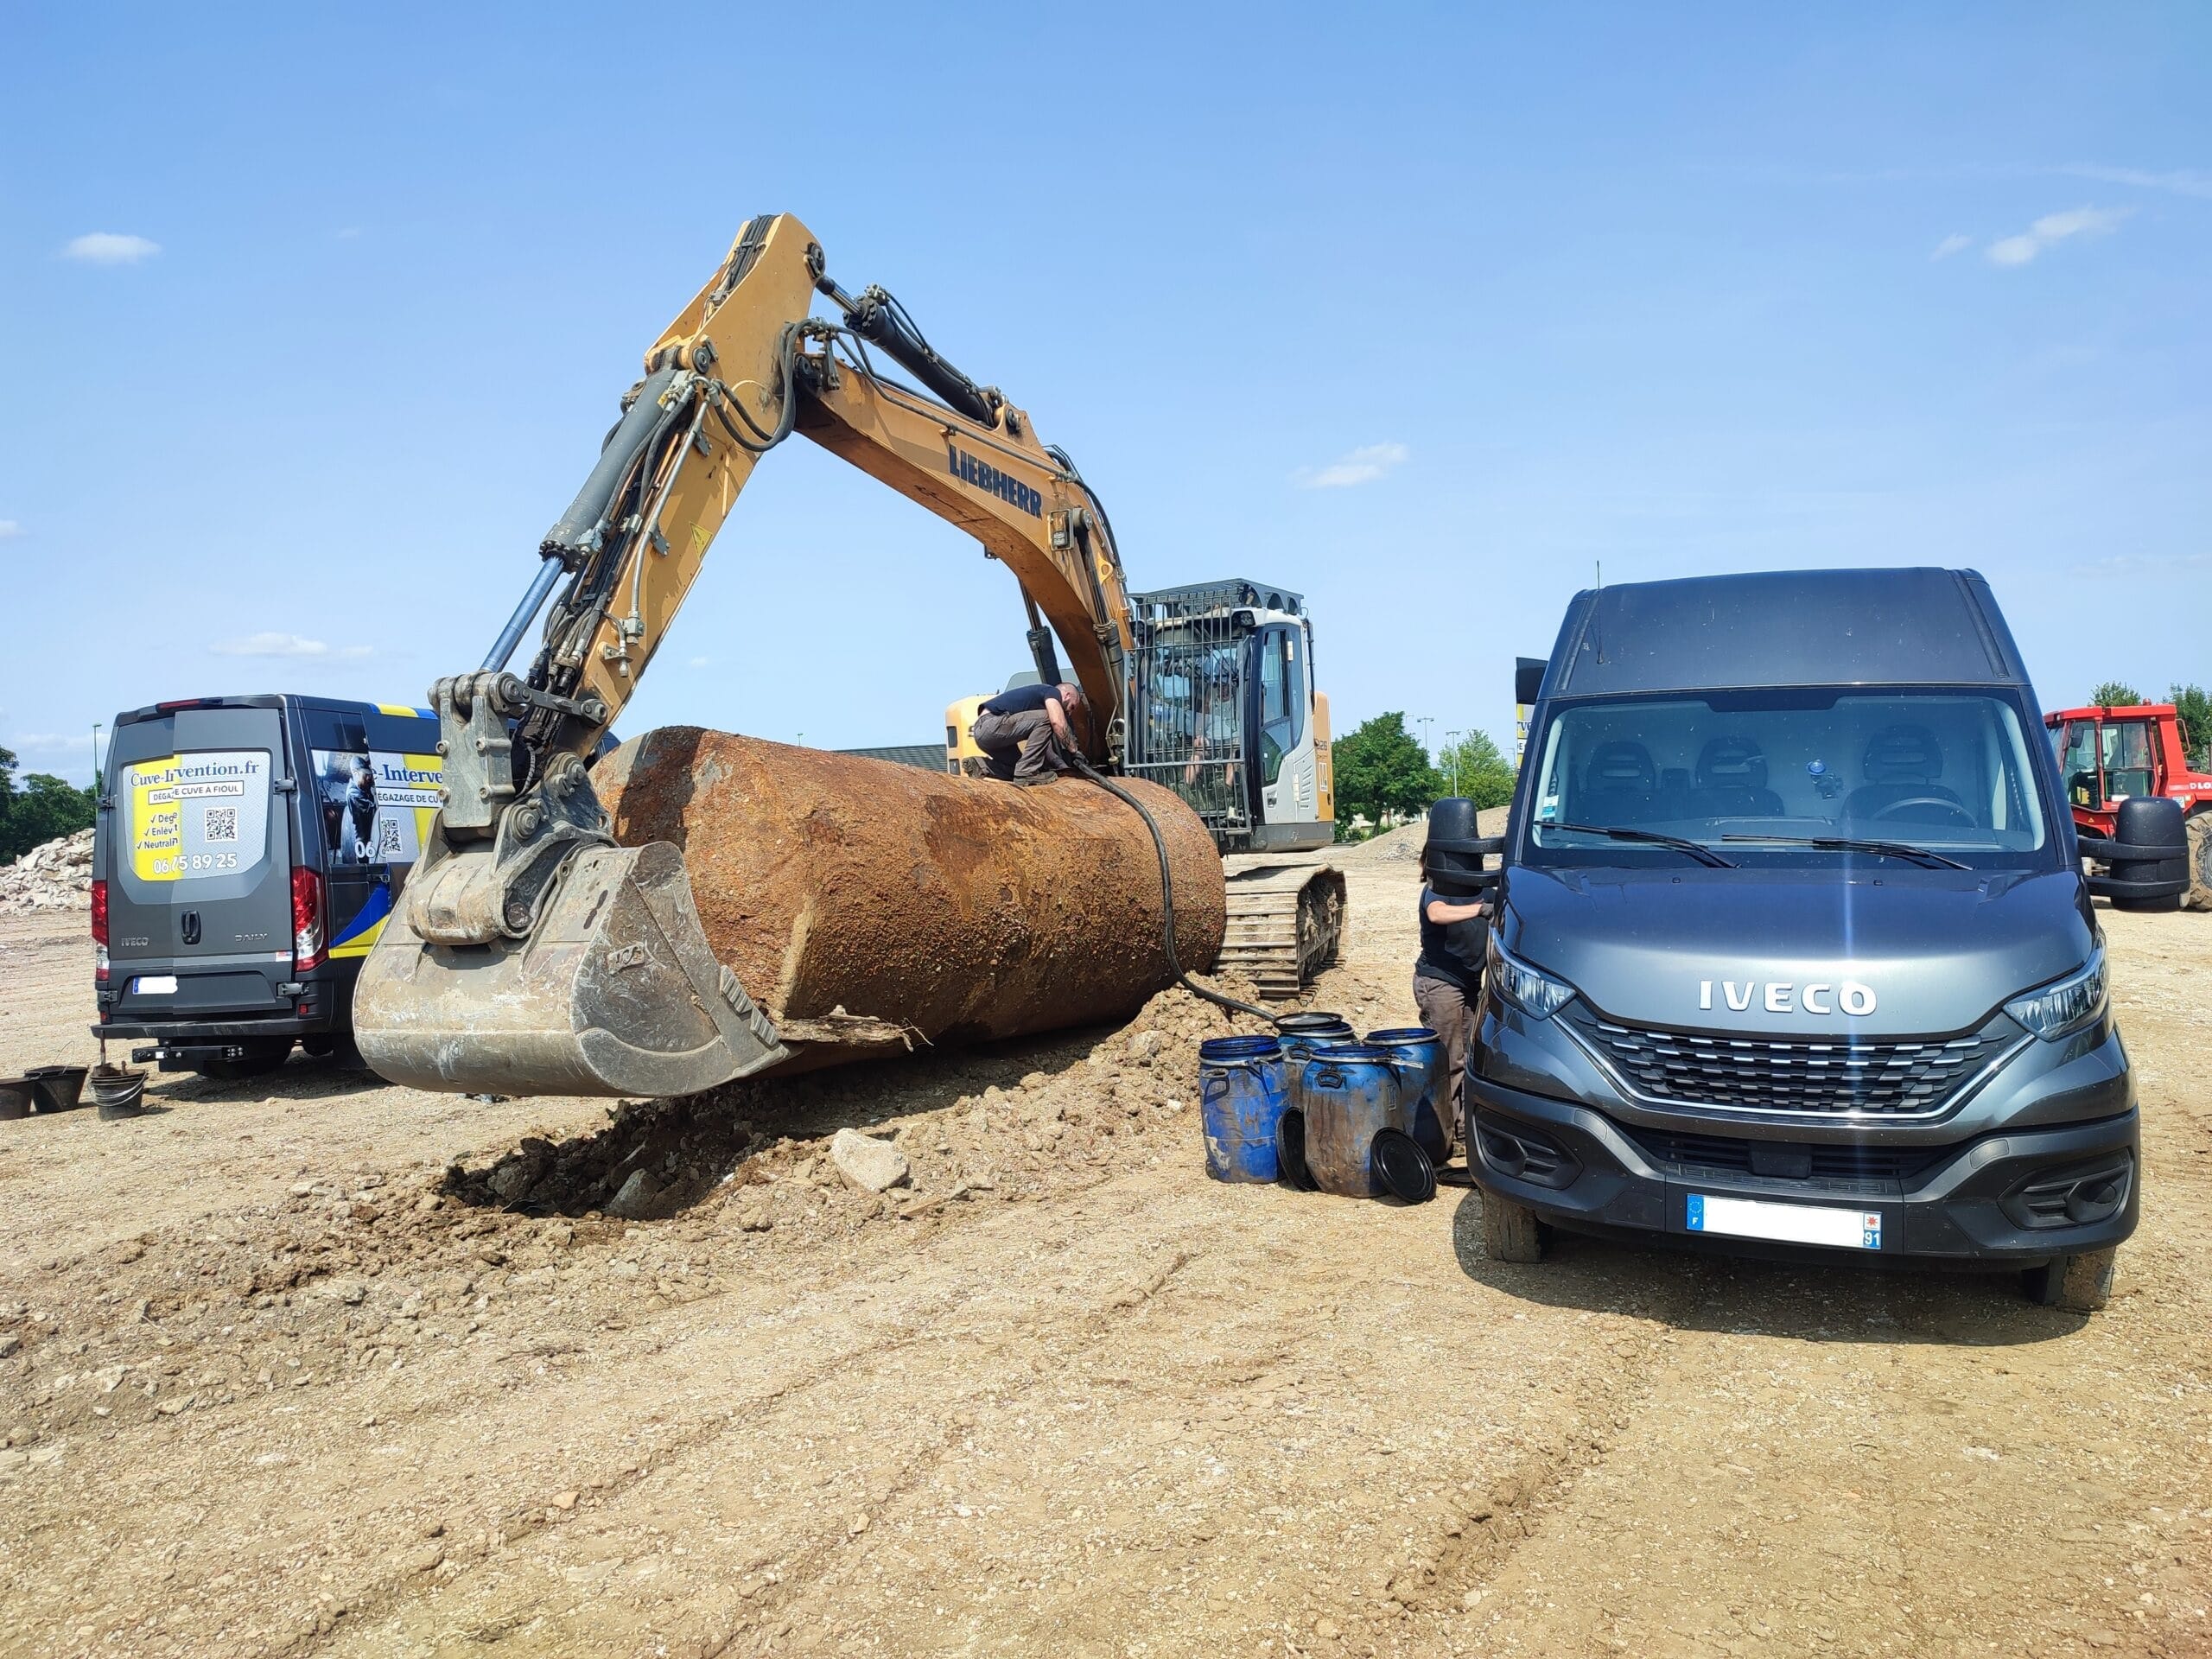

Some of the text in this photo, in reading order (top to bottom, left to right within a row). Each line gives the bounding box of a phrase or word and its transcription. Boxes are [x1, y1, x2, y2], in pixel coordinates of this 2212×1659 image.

[949, 443, 1042, 520] LIEBHERR
[181, 785, 204, 796] CUVE
[213, 784, 238, 794] FIOUL
[416, 794, 426, 803] DE
[428, 795, 442, 804] CU
[354, 840, 376, 858] 06
[153, 857, 170, 874] 06
[192, 854, 213, 870] 89
[216, 852, 238, 869] 25
[121, 937, 149, 947] IVECO
[234, 932, 268, 942] DAILY
[1699, 979, 1878, 1016] IVECO
[1692, 1217, 1699, 1225] F
[1865, 1231, 1880, 1246] 91
